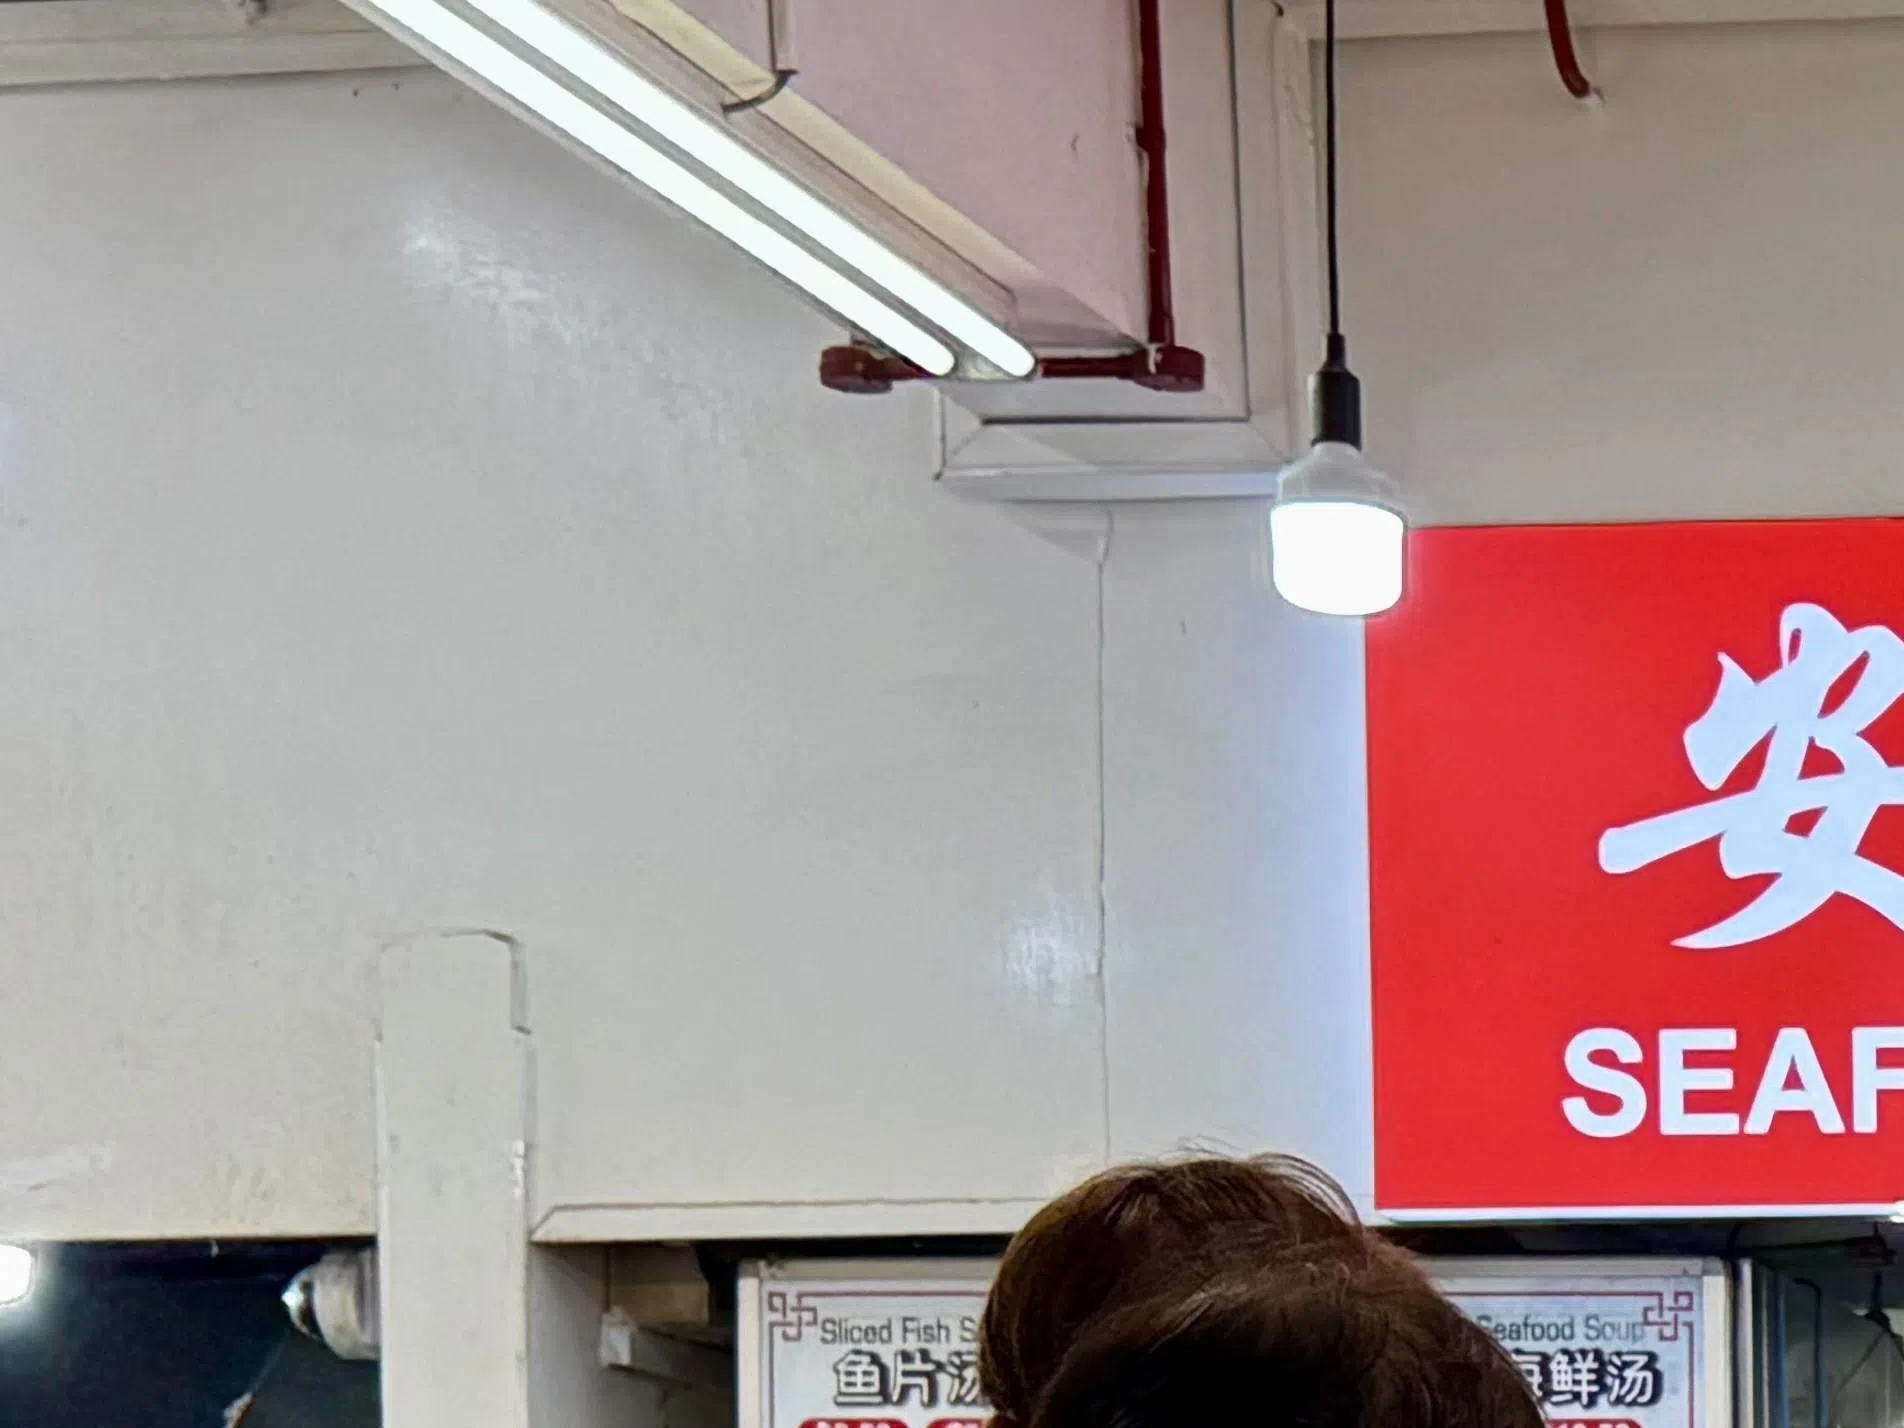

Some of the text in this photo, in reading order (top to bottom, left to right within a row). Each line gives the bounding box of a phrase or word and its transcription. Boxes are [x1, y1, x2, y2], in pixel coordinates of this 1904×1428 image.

[820, 1317, 893, 1345] Sliced
[902, 1317, 951, 1345] Fish
[1585, 1314, 1645, 1346] Soup
